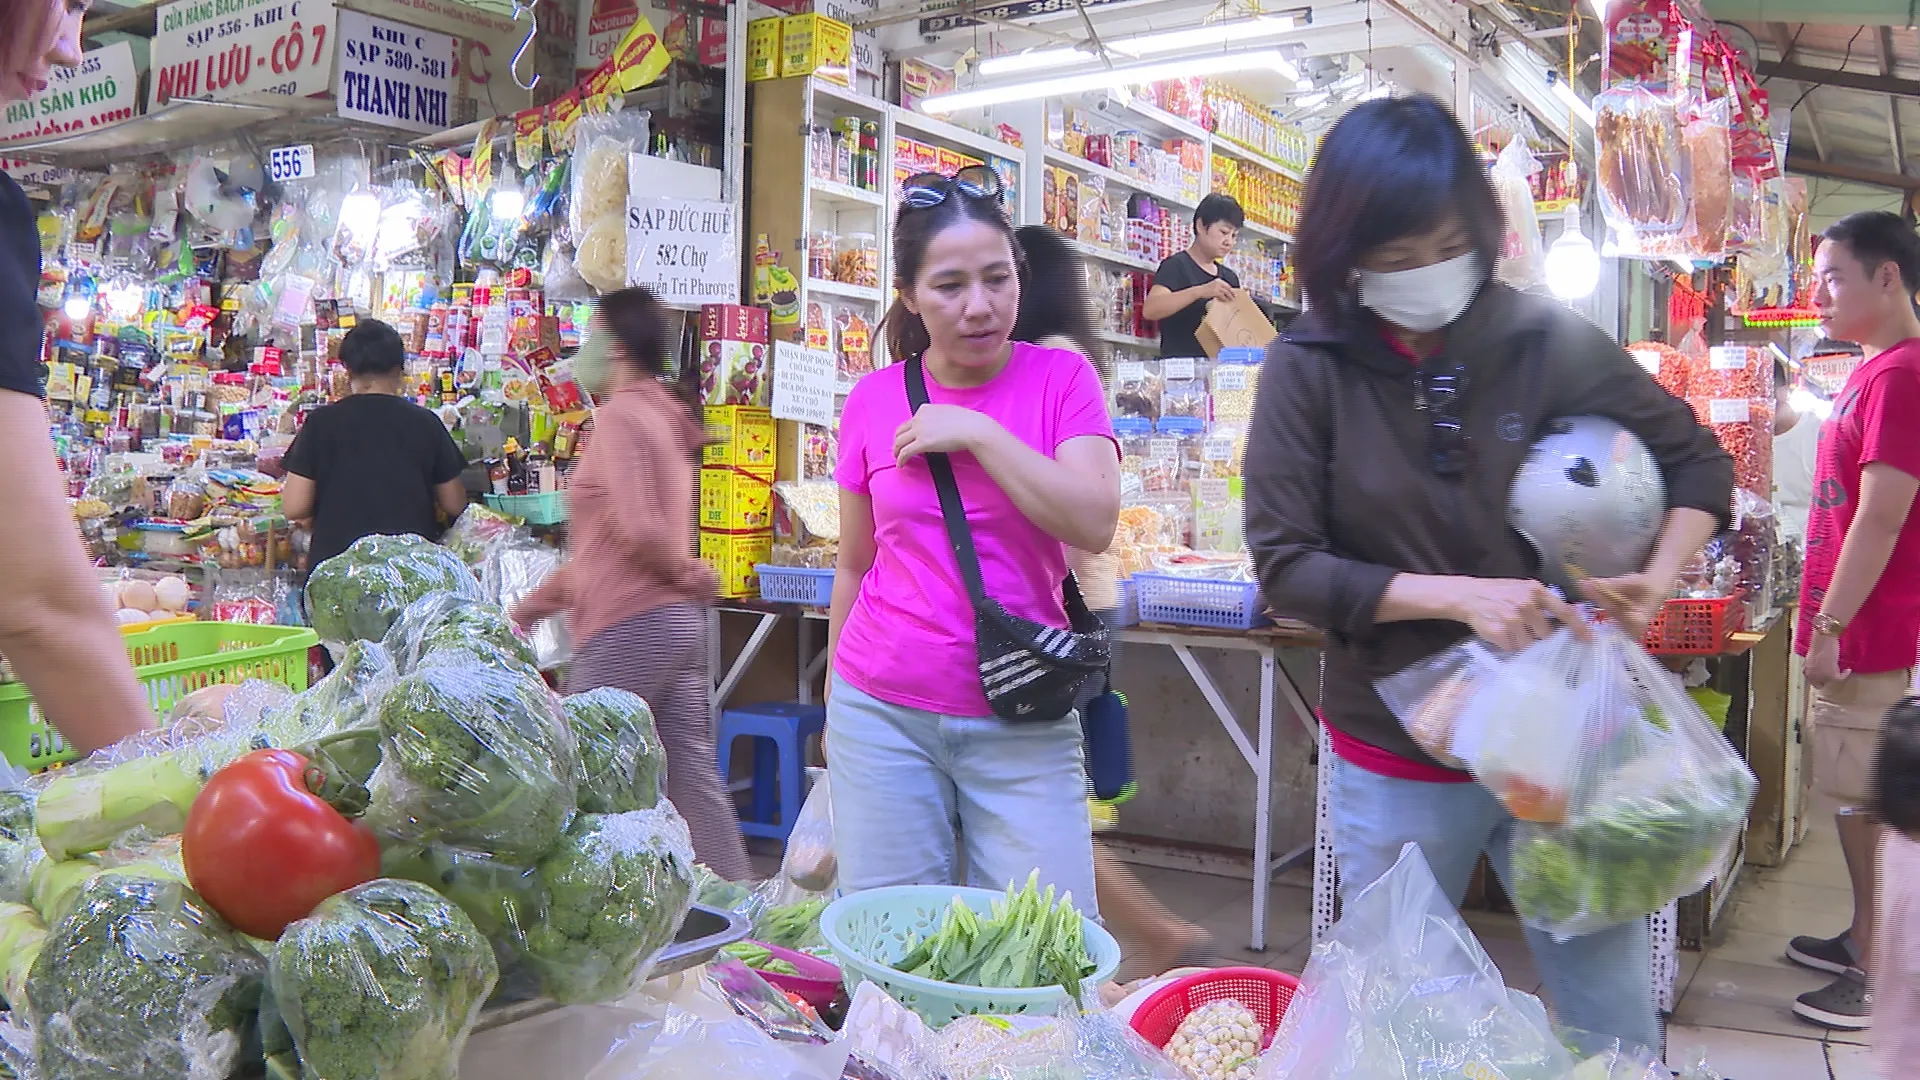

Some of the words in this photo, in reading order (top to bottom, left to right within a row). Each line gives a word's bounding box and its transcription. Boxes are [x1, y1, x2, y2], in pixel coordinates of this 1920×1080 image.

[217, 18, 242, 38] 556
[254, 4, 289, 28] KHU
[346, 38, 381, 66] SẠP
[372, 25, 411, 46] KHU
[414, 37, 426, 50] C
[80, 57, 102, 76] 555
[157, 58, 199, 103] NHI
[270, 20, 304, 75] CÔ
[312, 24, 327, 66] 7
[40, 87, 75, 116] SẢN
[79, 75, 117, 106] KHÔ
[344, 70, 411, 120] THANH
[415, 85, 447, 128] NHI
[272, 149, 302, 179] 556
[629, 206, 666, 236] SẠP
[668, 203, 699, 233] ĐỨC
[656, 244, 677, 266] 582
[681, 244, 709, 273] Chợ
[690, 277, 736, 300] Phương
